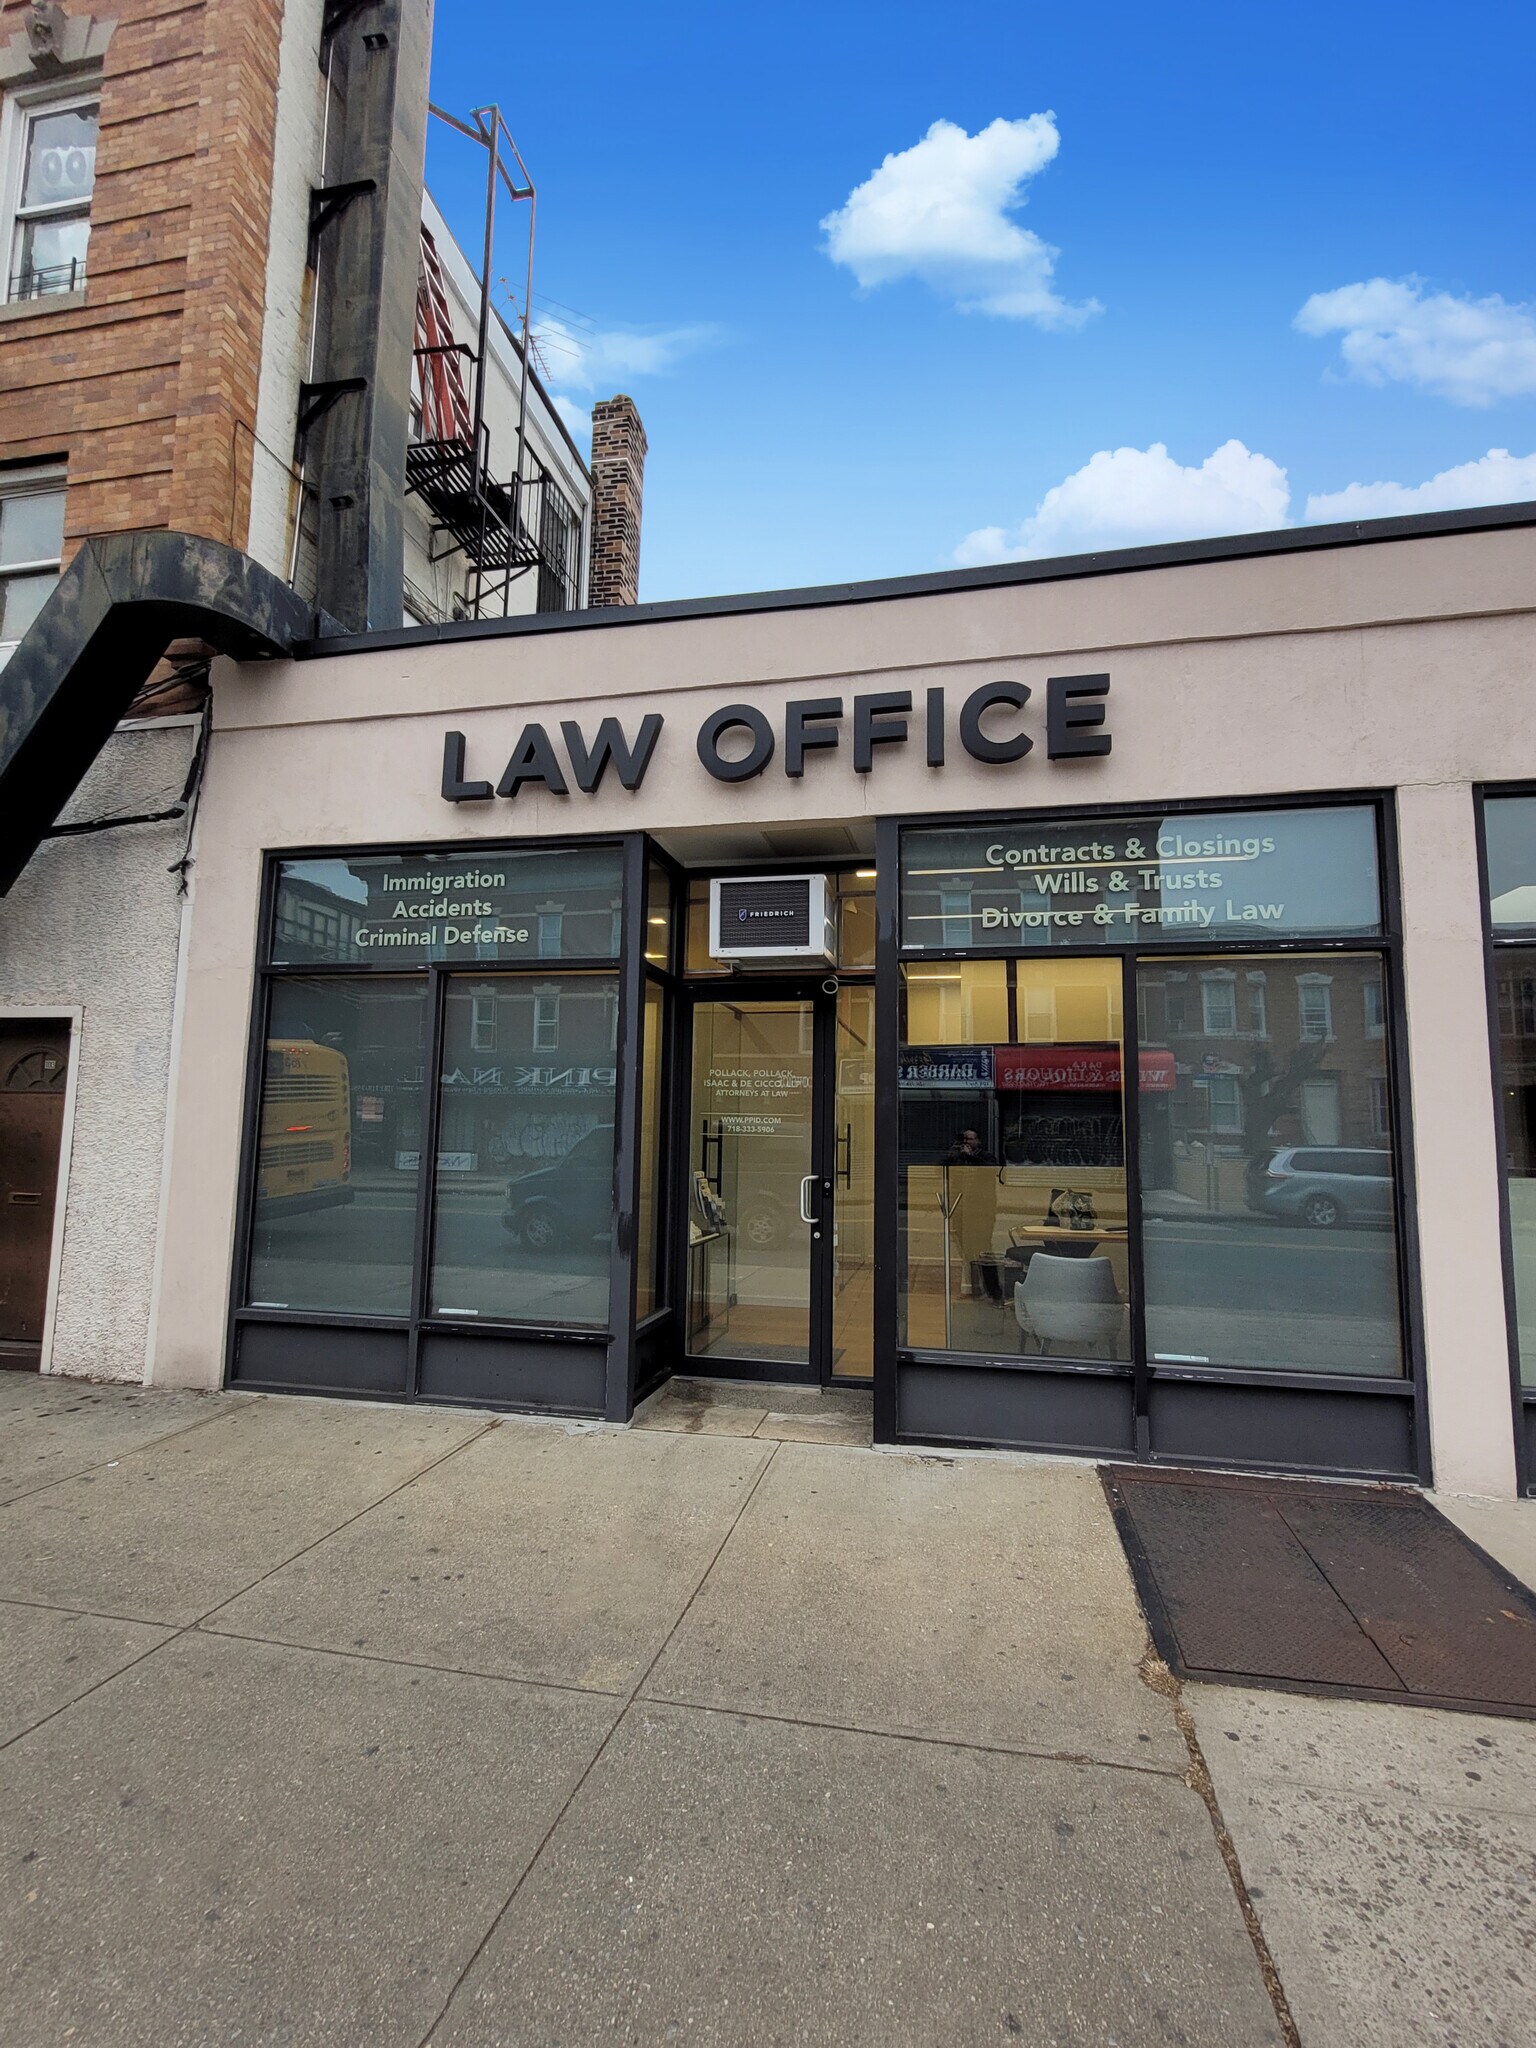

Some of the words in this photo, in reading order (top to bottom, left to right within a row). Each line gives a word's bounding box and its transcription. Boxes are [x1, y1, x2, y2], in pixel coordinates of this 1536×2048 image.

[441, 713, 664, 804] LAW
[696, 672, 1111, 784] OFFICE
[986, 839, 1116, 865] Contracts
[1124, 837, 1146, 859] &
[1155, 833, 1276, 860] Closings
[383, 869, 506, 895] Immigration
[1034, 871, 1099, 895] Wills
[1108, 871, 1130, 893] &
[1138, 868, 1223, 891] Trusts
[392, 898, 493, 919] Accidents
[750, 910, 794, 918] FRIEDRICH
[982, 906, 1084, 929] Divorce
[1093, 903, 1114, 926] &
[1124, 900, 1216, 928] Family
[1226, 899, 1285, 922] Law
[355, 926, 437, 947] Criminal
[443, 924, 529, 945] Defense
[704, 1079, 729, 1087] ISAAC
[731, 1079, 738, 1087] &
[740, 1080, 752, 1088] DE
[709, 1069, 751, 1078] POLLACK,
[753, 1069, 796, 1078] POLLACK,
[715, 1089, 759, 1097] ATTORNEYS
[721, 1116, 782, 1125] WWW.PPID.COM
[727, 1125, 775, 1133] 718-333-5906
